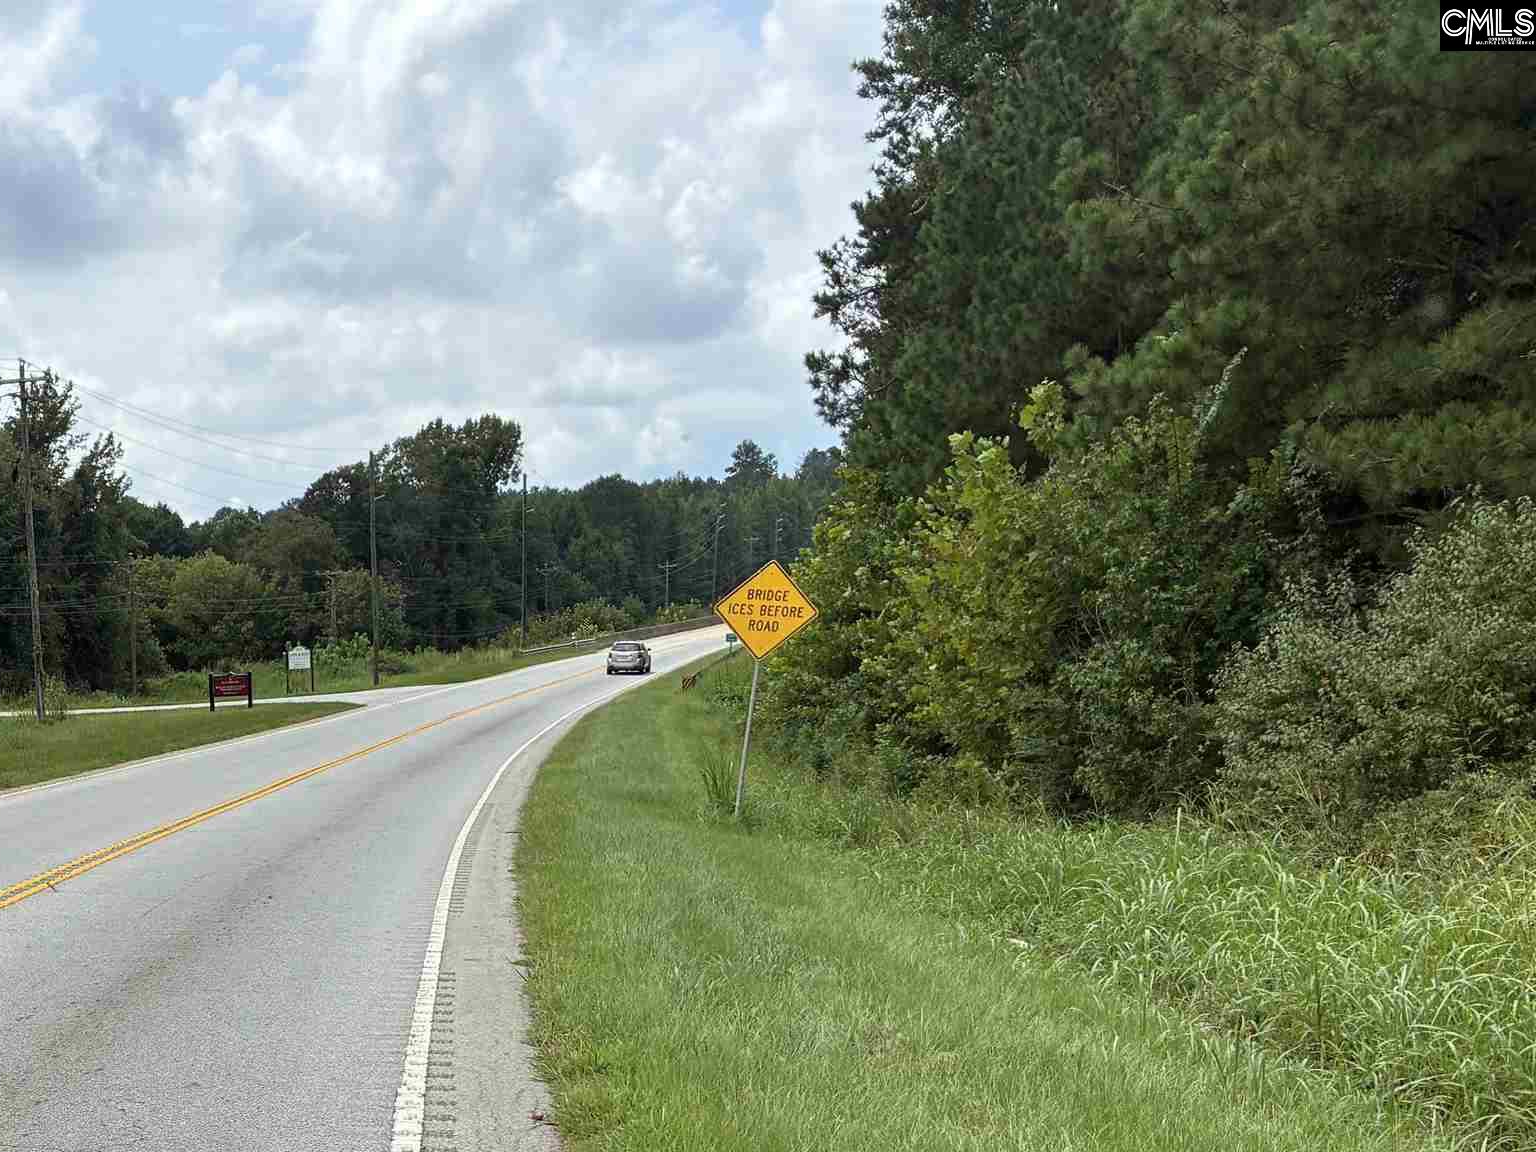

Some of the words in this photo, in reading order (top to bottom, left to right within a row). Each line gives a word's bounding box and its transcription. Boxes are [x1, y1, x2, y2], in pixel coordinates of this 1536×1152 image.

[747, 588, 791, 602] BRIDGE
[728, 603, 754, 616] ICES
[759, 604, 804, 618] BEFORE
[748, 619, 780, 633] ROAD
